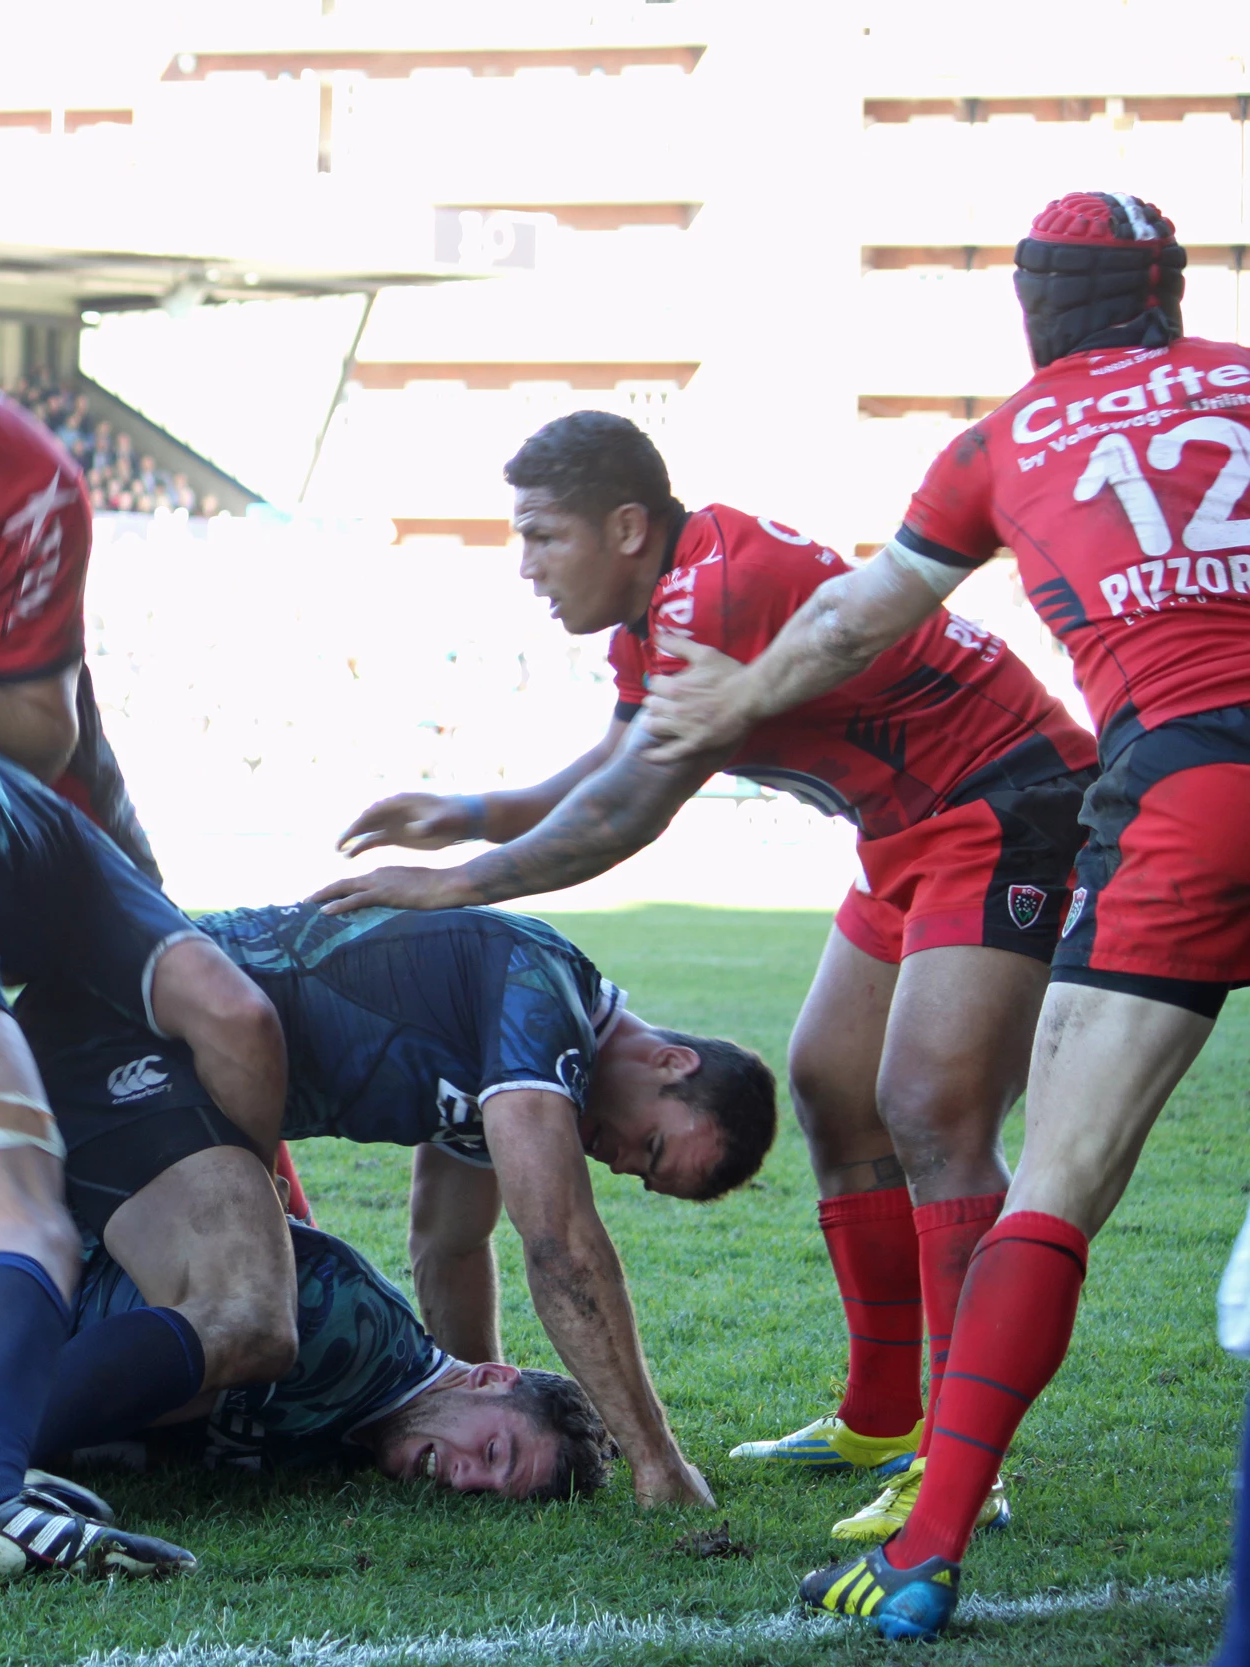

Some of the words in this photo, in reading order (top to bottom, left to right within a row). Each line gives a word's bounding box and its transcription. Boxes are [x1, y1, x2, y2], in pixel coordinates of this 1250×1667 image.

[1012, 364, 1250, 444] Crafte
[1017, 450, 1046, 472] by
[1048, 409, 1186, 451] Volkswage
[1073, 416, 1250, 556] 12
[1099, 554, 1250, 616] PIZZOR
